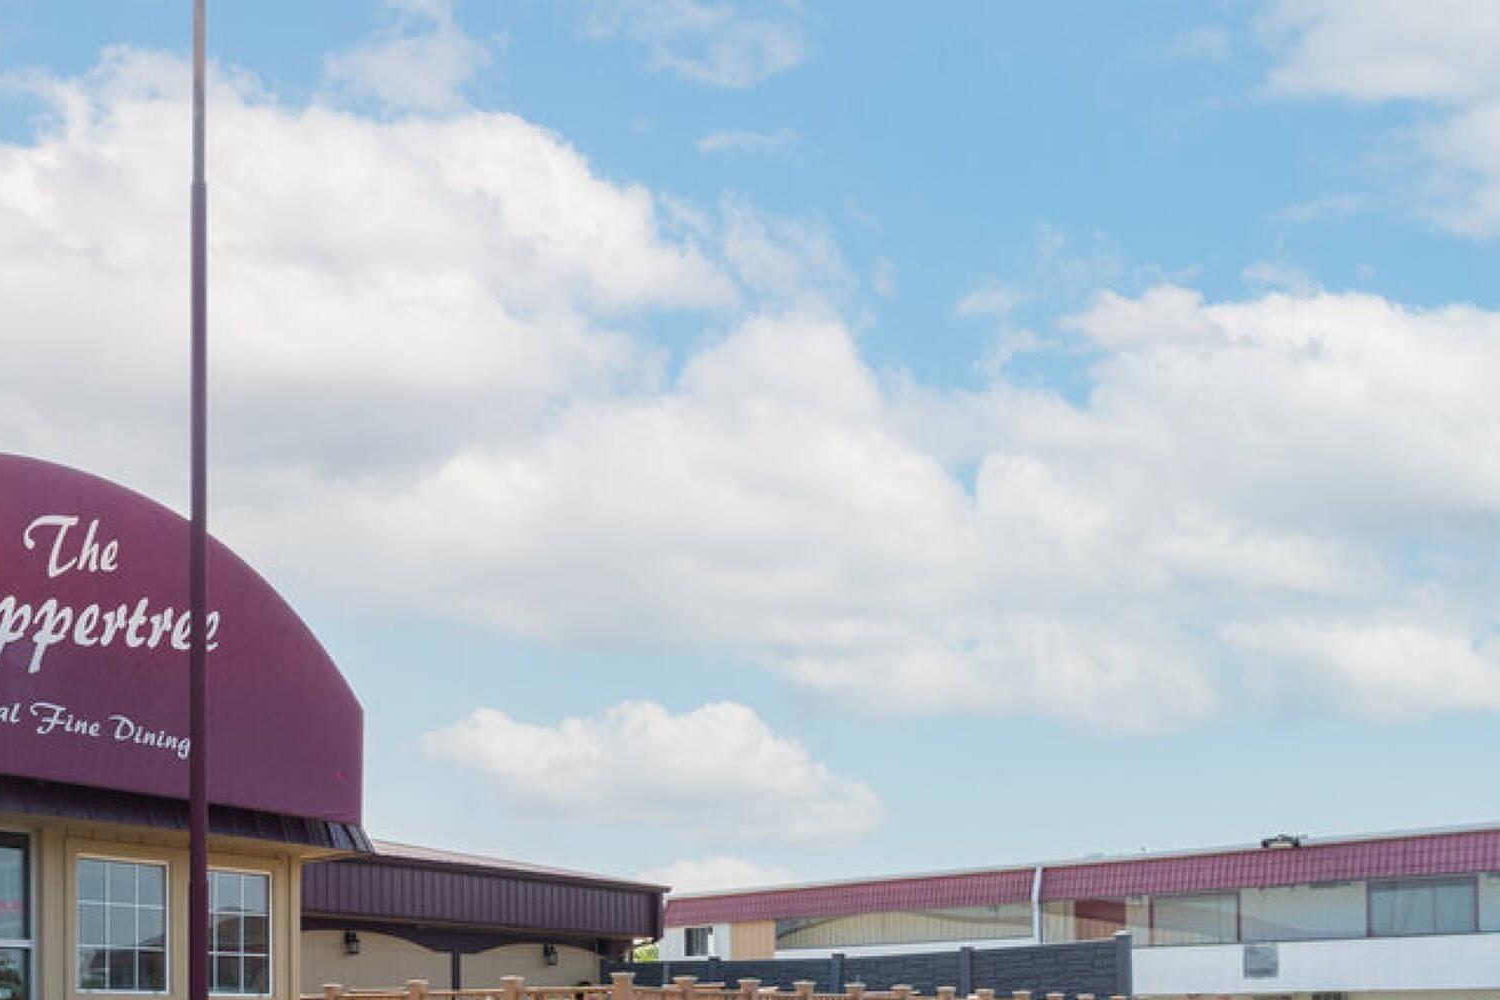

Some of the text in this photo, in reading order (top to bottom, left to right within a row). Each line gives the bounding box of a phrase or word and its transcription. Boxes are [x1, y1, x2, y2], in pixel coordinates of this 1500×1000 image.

[23, 514, 119, 578] The
[29, 701, 101, 736] Fine
[108, 713, 191, 760] Dining
